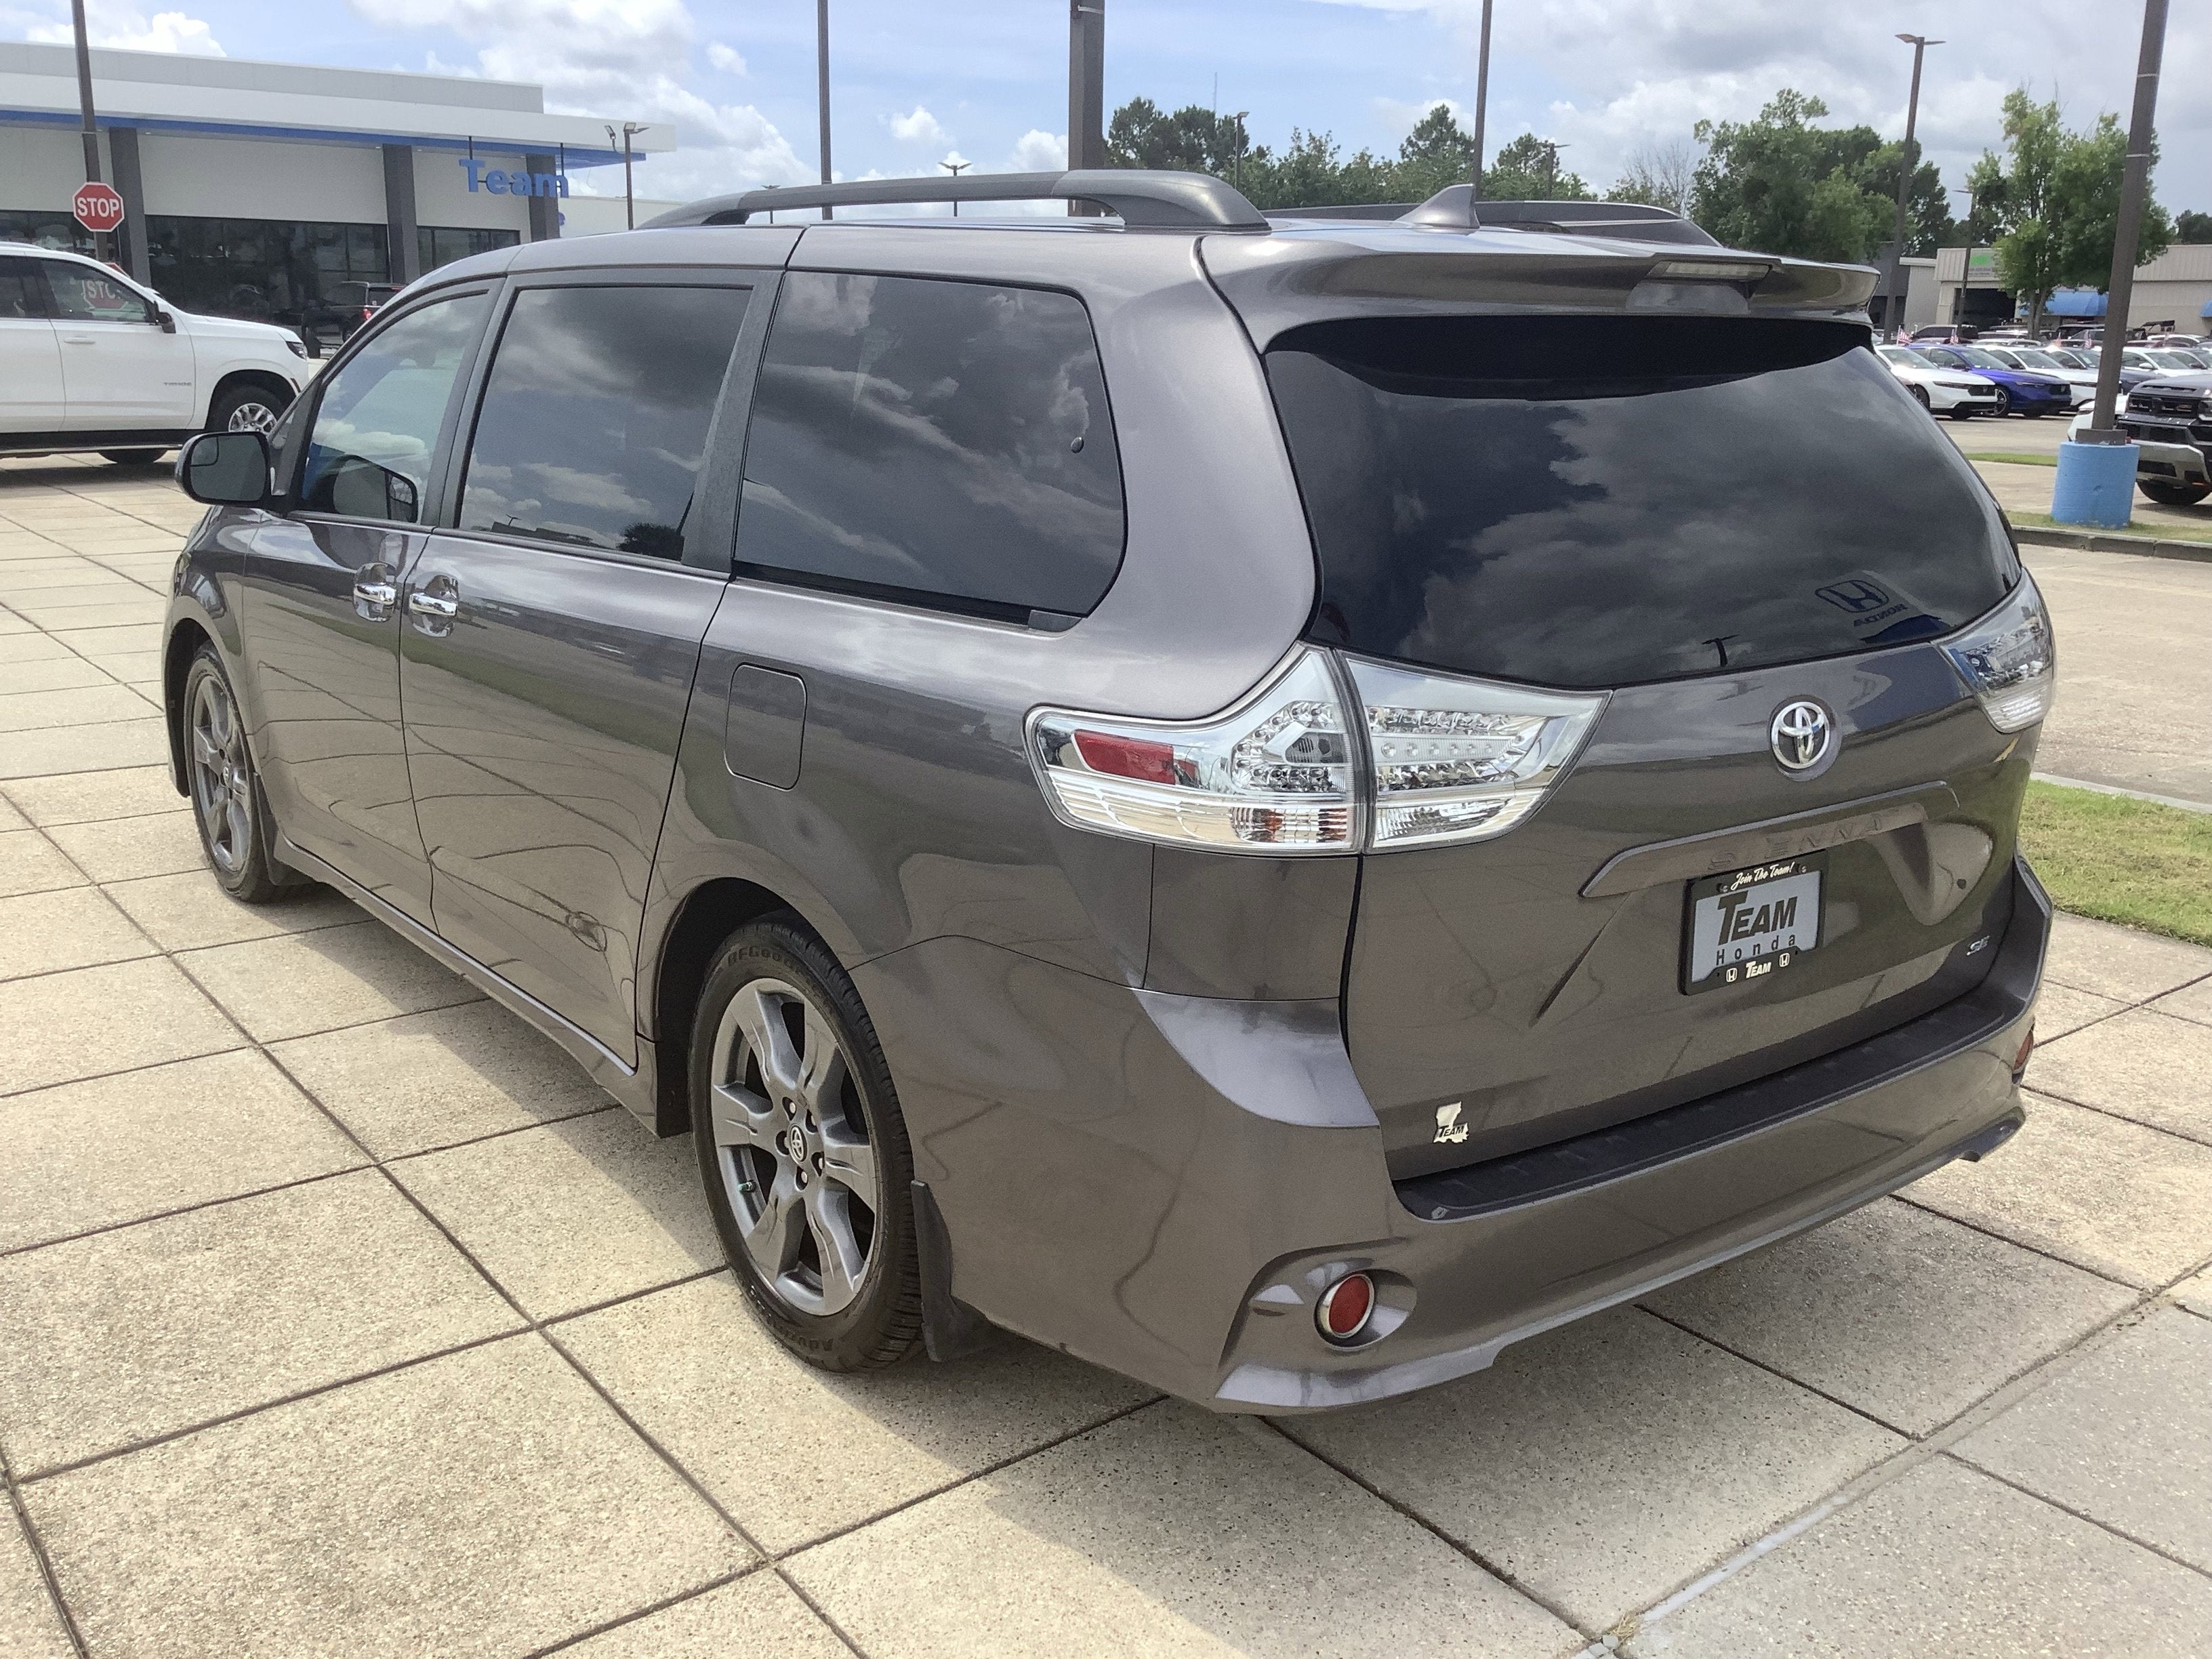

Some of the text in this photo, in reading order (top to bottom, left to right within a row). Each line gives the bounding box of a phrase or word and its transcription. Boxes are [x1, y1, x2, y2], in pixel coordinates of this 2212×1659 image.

[459, 159, 569, 198] Team
[77, 197, 119, 217] STOP
[1708, 813, 1883, 869] SENNA
[1730, 861, 1795, 890] Join The Team!
[1717, 890, 1797, 945] TEAM
[1716, 934, 1795, 965] Honda
[1746, 961, 1771, 978] TEAM
[1439, 1125, 1465, 1138] TEAM
